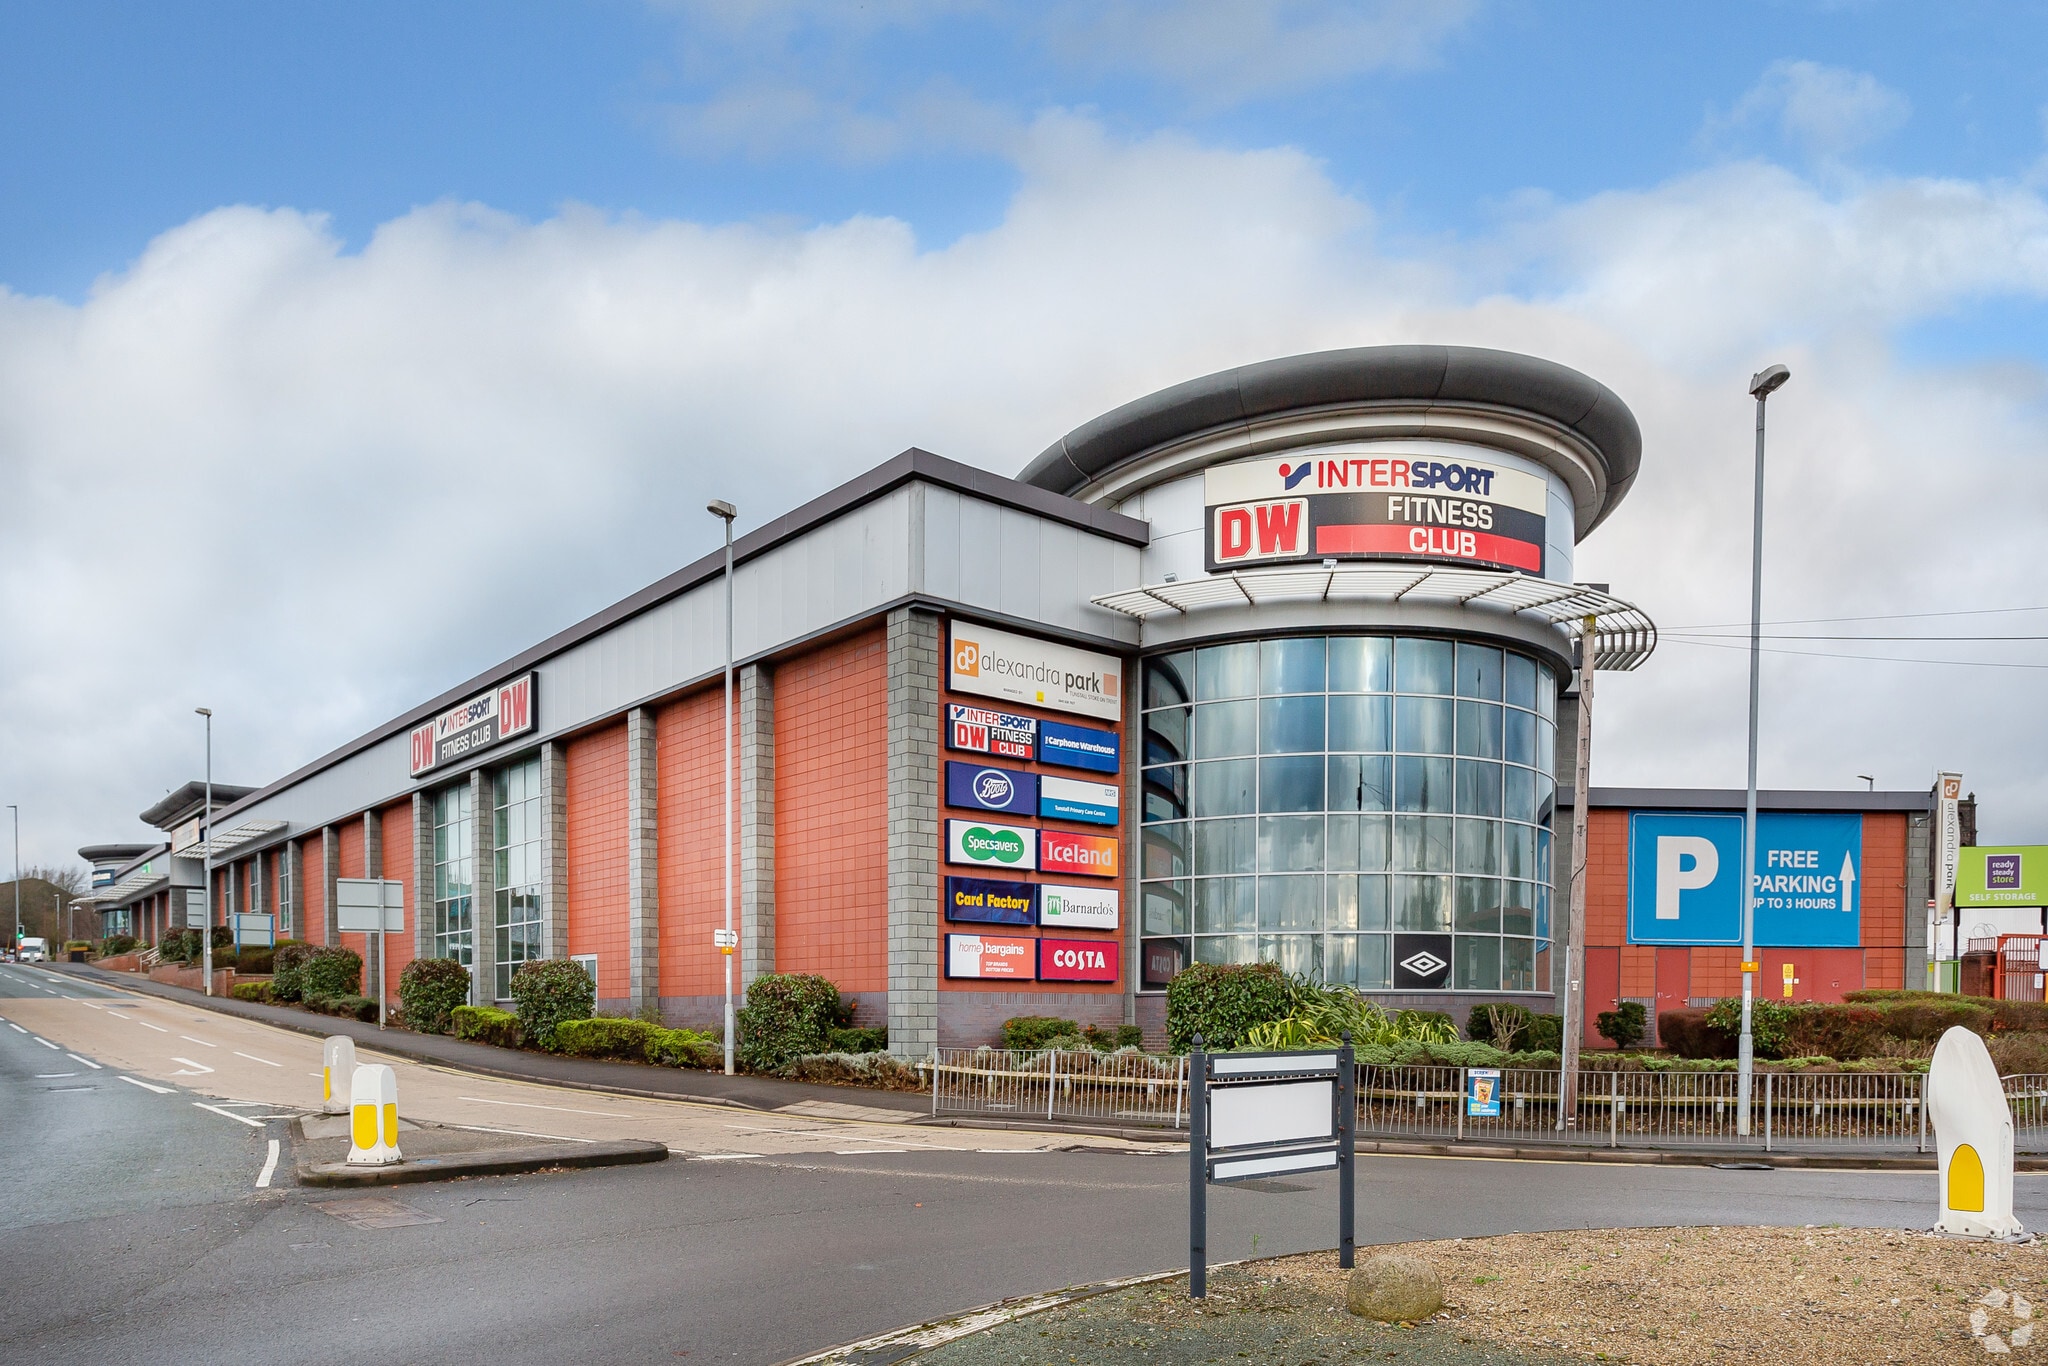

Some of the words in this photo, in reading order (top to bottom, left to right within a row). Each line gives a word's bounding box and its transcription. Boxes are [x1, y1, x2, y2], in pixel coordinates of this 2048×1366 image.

[1318, 459, 1495, 495] INTERSPORT
[1387, 496, 1493, 530] FITNESS
[1219, 502, 1302, 561] DW
[1409, 527, 1477, 557] CLUB
[981, 650, 1060, 686] alexandra
[1065, 671, 1100, 694] park
[447, 696, 491, 732] INTERSPORT
[500, 680, 529, 735] DW
[967, 709, 1031, 731] INTERSPORT
[441, 734, 470, 760] FITNESS
[471, 724, 491, 748] CLUB
[957, 723, 986, 750] DW
[991, 727, 1032, 745] FITNESS
[1048, 736, 1079, 749] Carphone
[1080, 742, 1115, 755] Warehouse
[412, 725, 434, 772] DW
[999, 741, 1025, 757] CLUB
[980, 778, 1008, 799] Boots
[1946, 802, 1955, 861] alexandra
[967, 835, 1019, 853] Specsavers
[1048, 841, 1112, 867] Iceland
[1767, 850, 1819, 868] FREE
[1992, 860, 2014, 870] ready
[1656, 836, 1720, 920] P
[1753, 874, 1836, 894] PARKING
[1945, 863, 1953, 889] park
[1992, 876, 2014, 884] store
[955, 891, 983, 907] Card
[987, 894, 1030, 913] Factory
[1062, 899, 1114, 916] Barnardo's
[1767, 898, 1783, 909] TO
[1786, 898, 1792, 909] 3
[1795, 898, 1836, 909] HOURS
[1969, 893, 1991, 901] SELF
[1993, 892, 2037, 901] STORAGE
[958, 942, 982, 953] home
[985, 942, 1025, 957] bargains
[1053, 949, 1106, 971] COSTA
